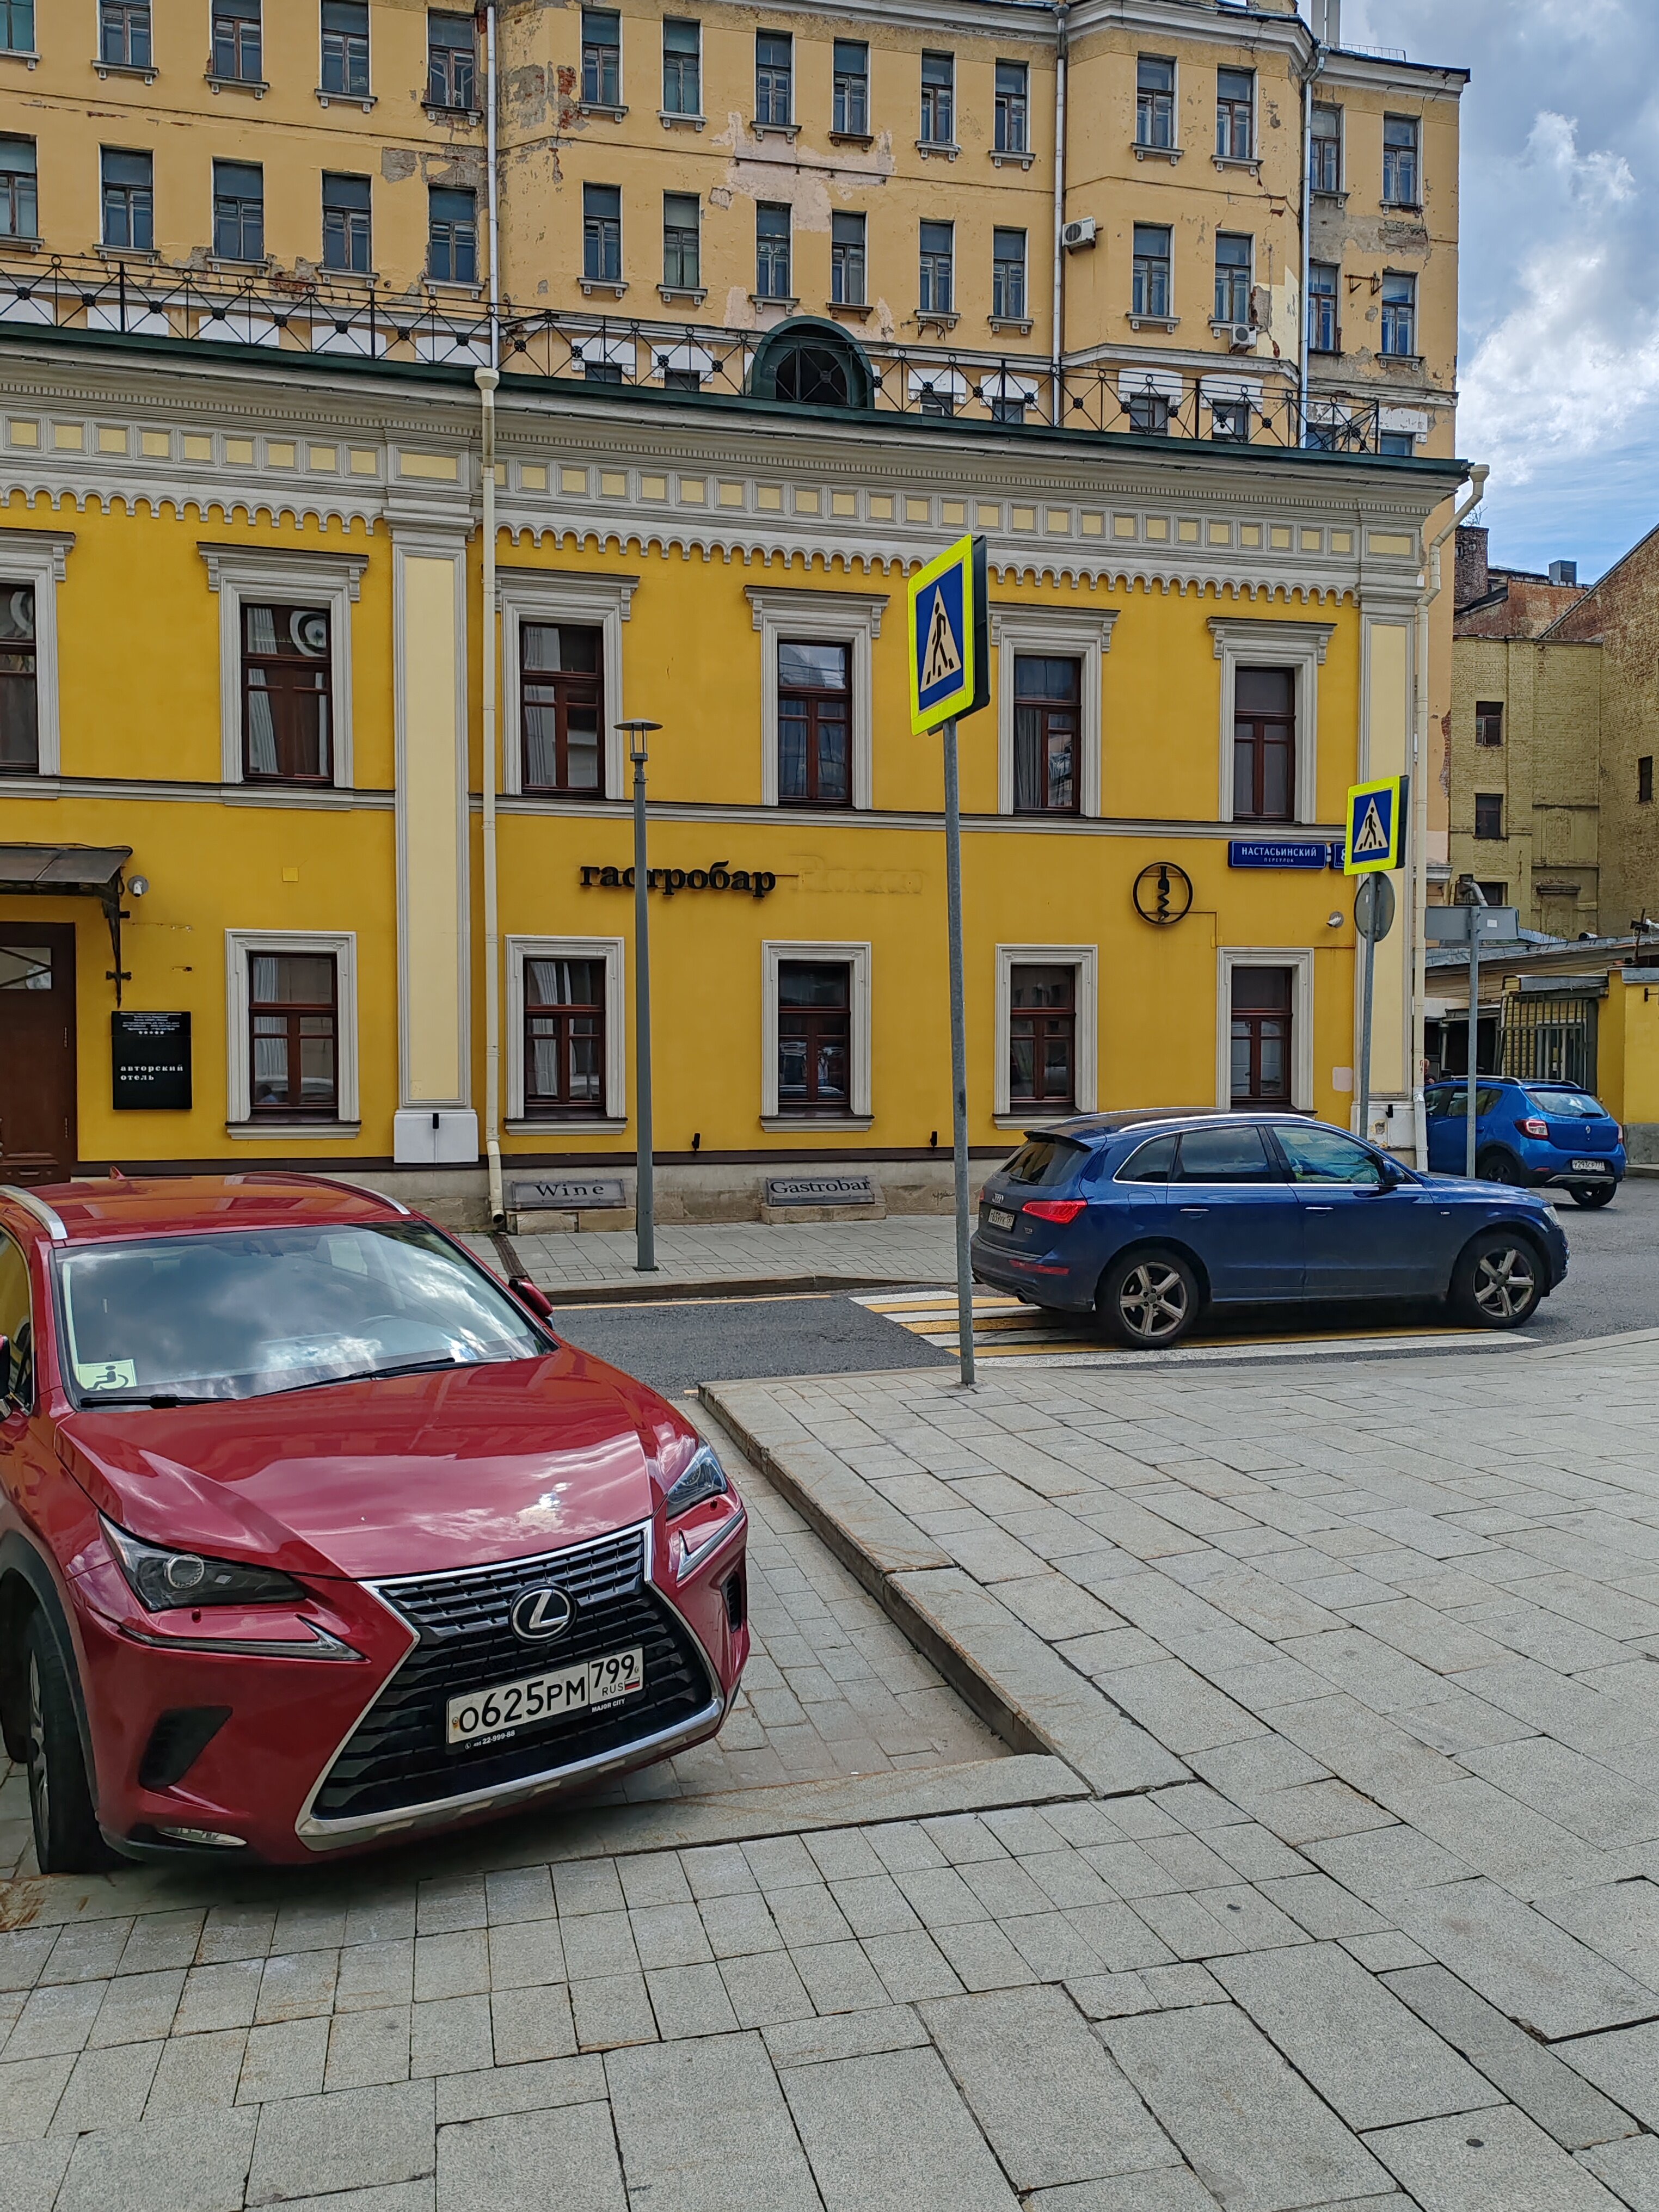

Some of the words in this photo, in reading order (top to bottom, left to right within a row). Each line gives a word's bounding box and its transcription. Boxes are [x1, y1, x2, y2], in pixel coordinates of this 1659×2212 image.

[1242, 846, 1317, 857] НАСТАСЬИНСКИЙ
[120, 1064, 183, 1073] авторский
[533, 1183, 605, 1197] Wine
[769, 1177, 871, 1195] Gastrobar
[591, 1654, 636, 1688] 799
[601, 1682, 624, 1697] RUS
[591, 1701, 612, 1713] MAJOR
[612, 1697, 625, 1708] CITY
[482, 1730, 515, 1744] 22-999-88
